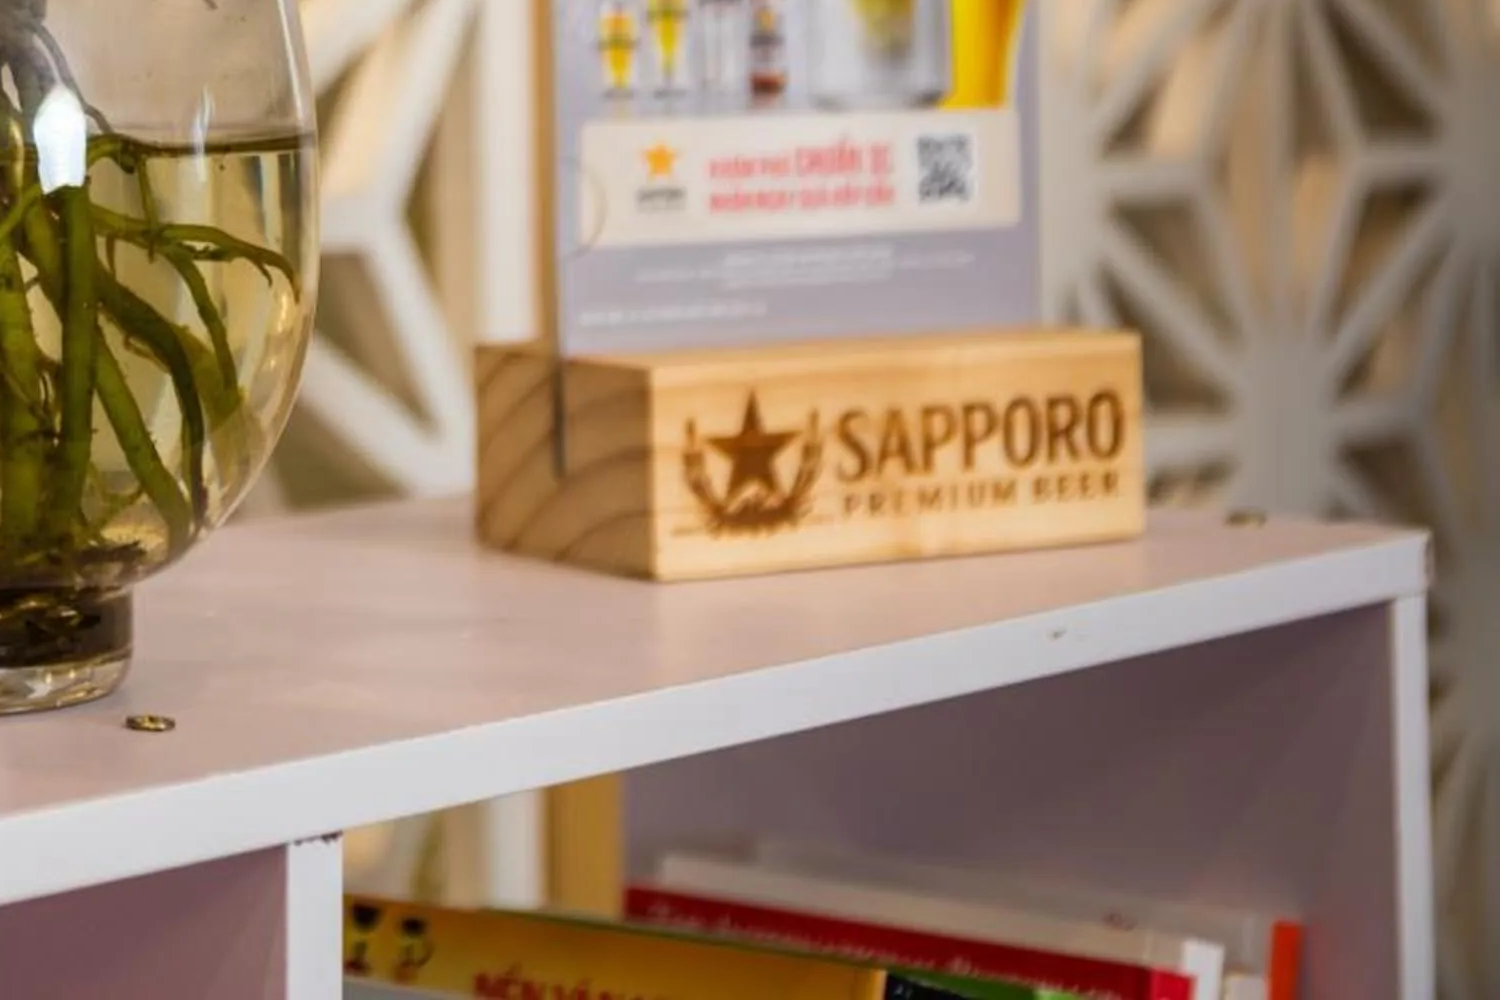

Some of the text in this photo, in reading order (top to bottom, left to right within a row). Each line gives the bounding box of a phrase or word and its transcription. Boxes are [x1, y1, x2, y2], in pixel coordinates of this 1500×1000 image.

[836, 387, 1125, 483] SAPPORO
[843, 470, 1120, 517] PREMIUM BEER
